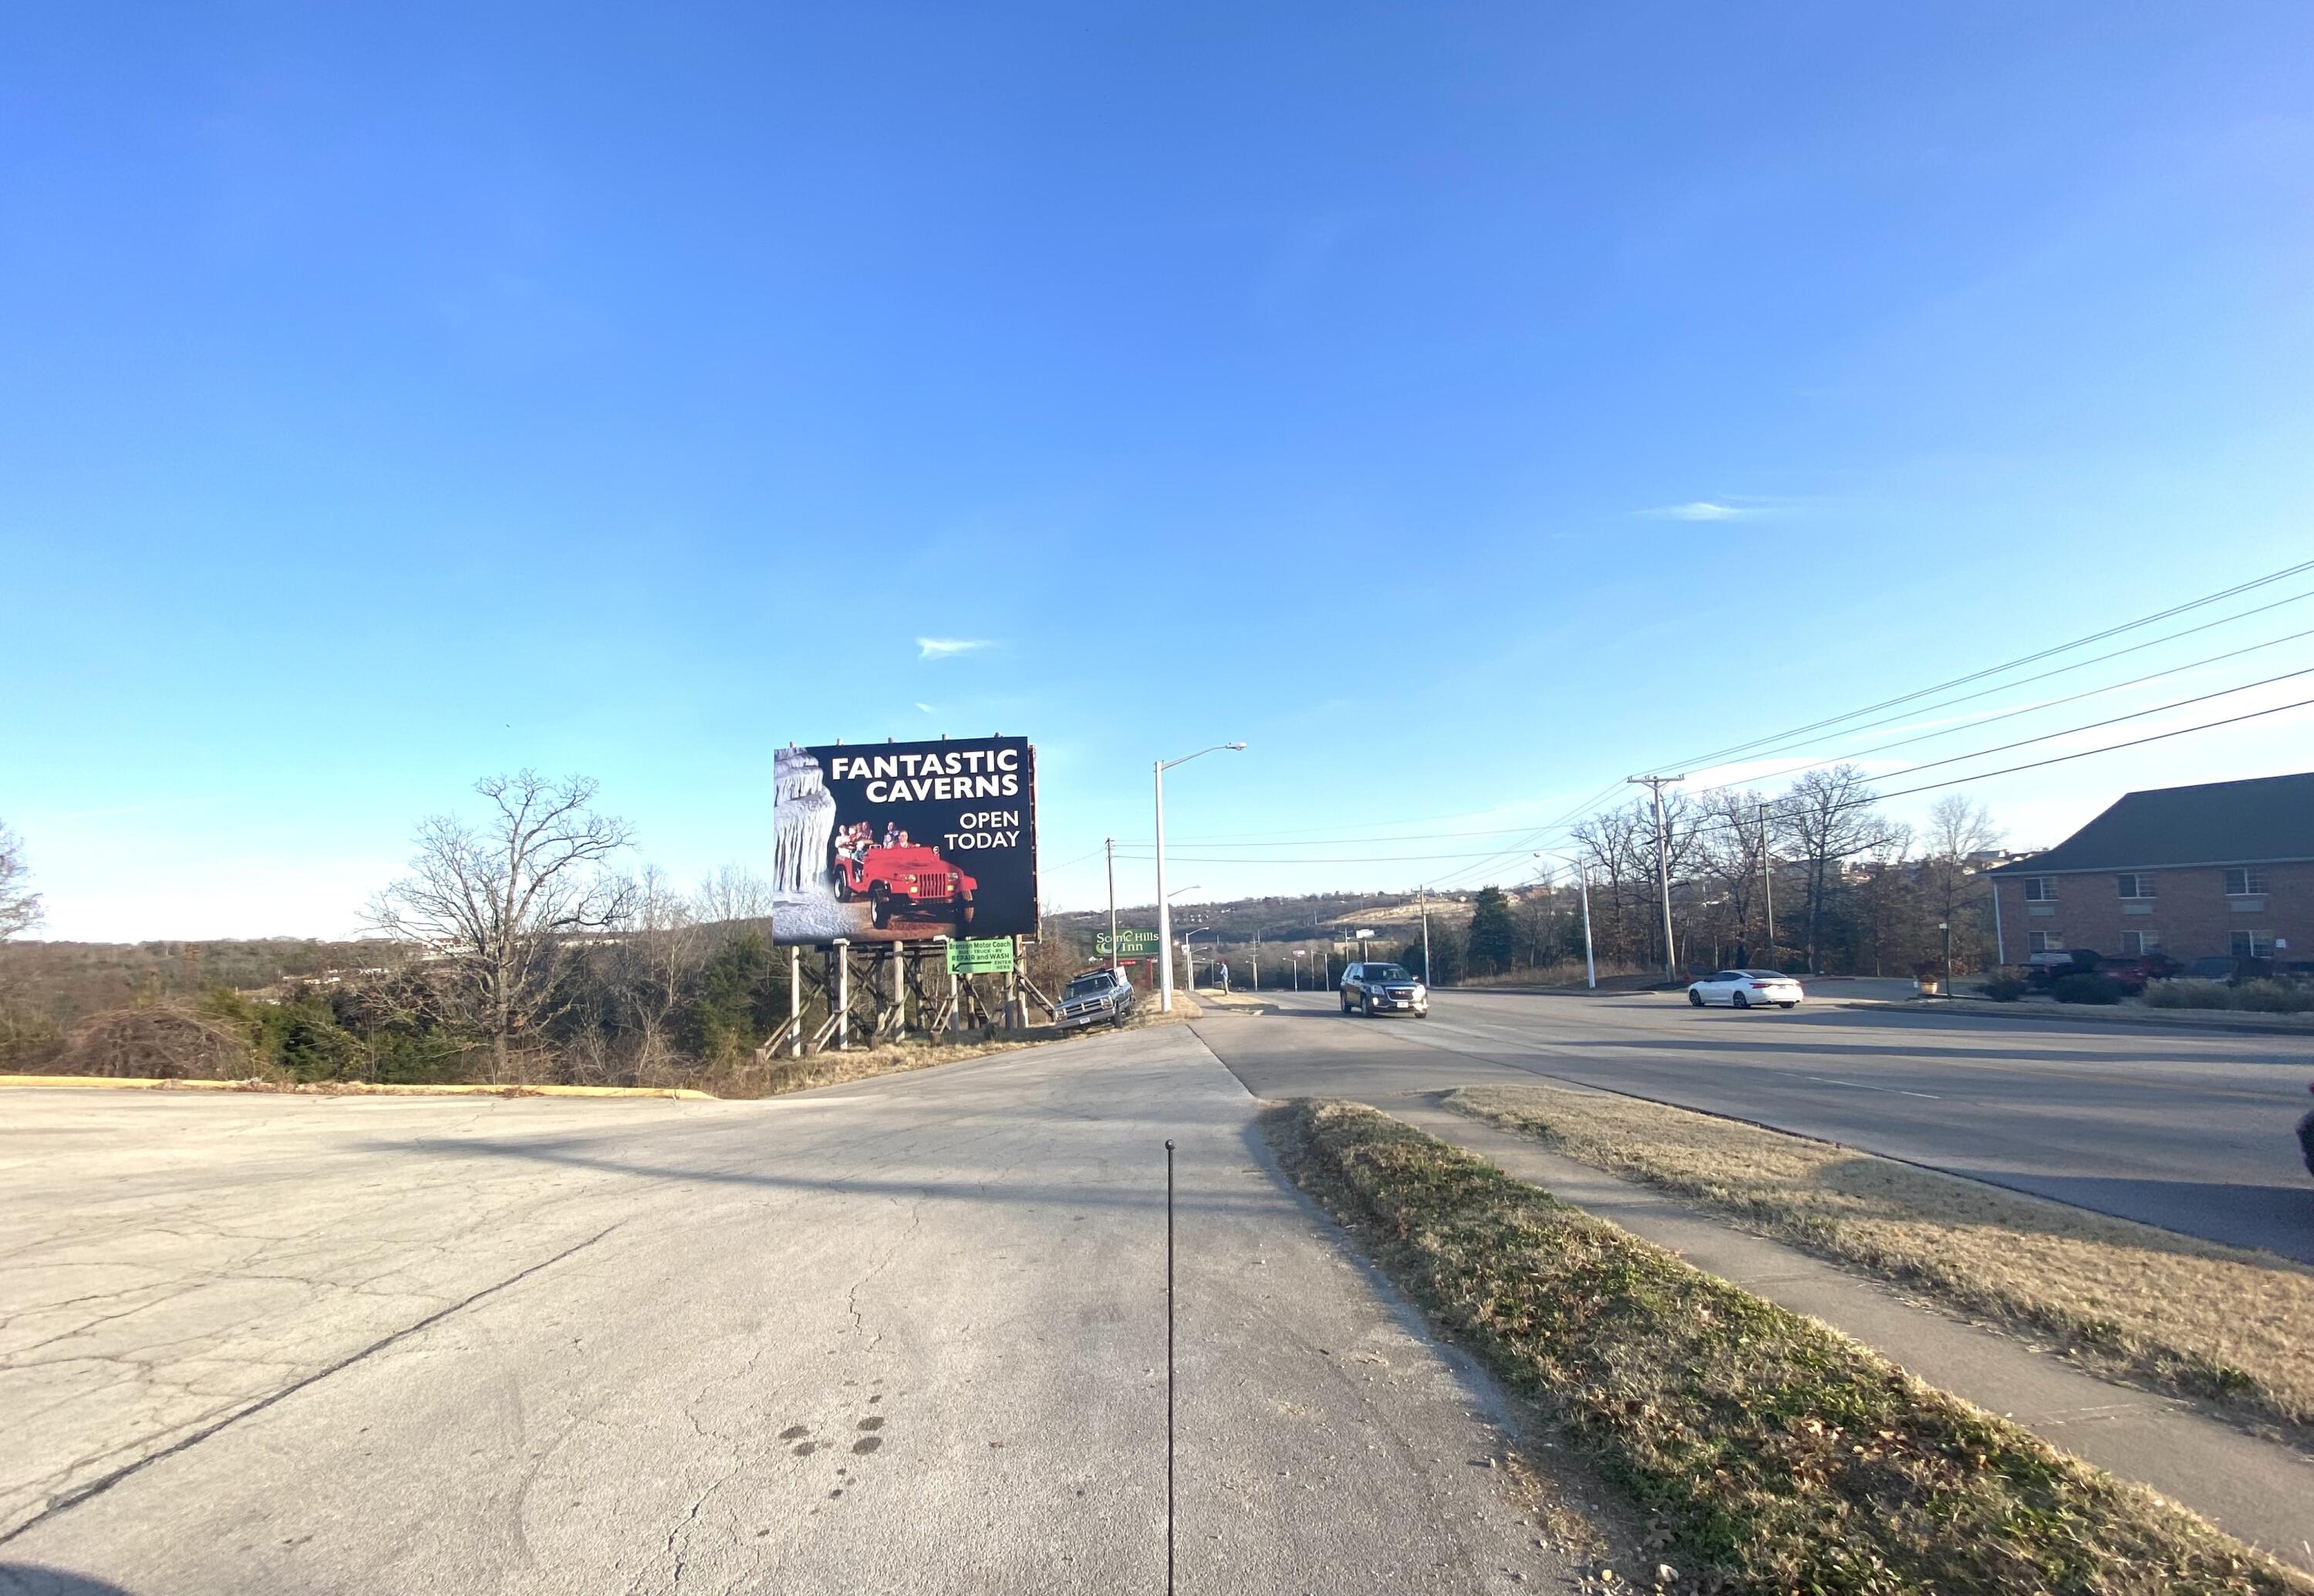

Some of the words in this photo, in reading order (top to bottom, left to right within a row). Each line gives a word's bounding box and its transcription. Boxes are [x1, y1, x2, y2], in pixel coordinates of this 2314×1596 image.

[832, 749, 1018, 780] FANTASTIC
[865, 774, 1019, 804] CAVERNS
[959, 811, 1019, 829] OPEN
[943, 830, 1020, 851] TODAY
[1096, 933, 1132, 943] Scnic
[1135, 932, 1159, 941] Hills
[1122, 943, 1143, 951] Inn
